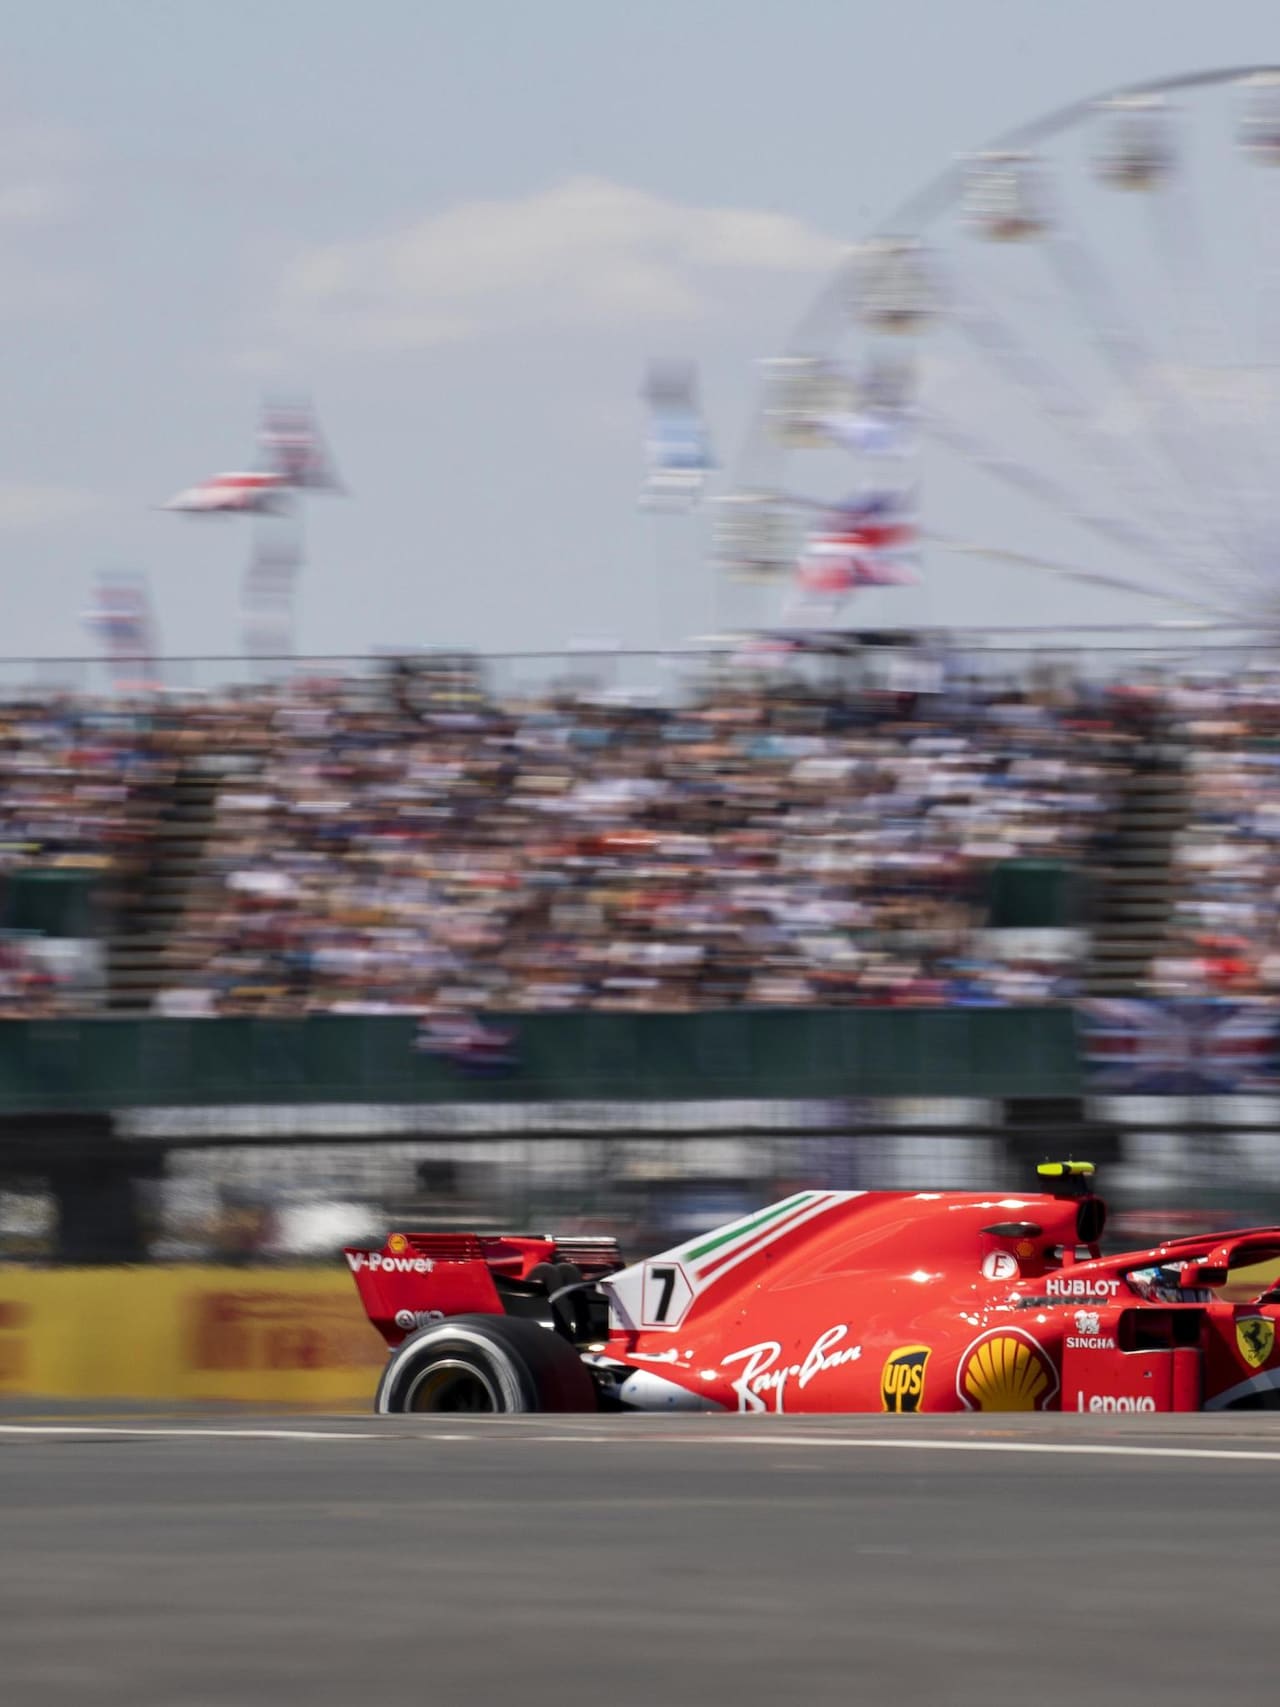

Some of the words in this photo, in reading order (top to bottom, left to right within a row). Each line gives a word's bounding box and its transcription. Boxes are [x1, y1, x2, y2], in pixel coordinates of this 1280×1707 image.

[345, 1252, 434, 1273] V-Power
[993, 1255, 1007, 1277] E
[651, 1267, 676, 1322] 7
[1046, 1279, 1120, 1297] HUBLOT
[1066, 1336, 1115, 1350] SINGHA
[884, 1363, 923, 1413] ups
[1077, 1390, 1156, 1413] Lenovo
